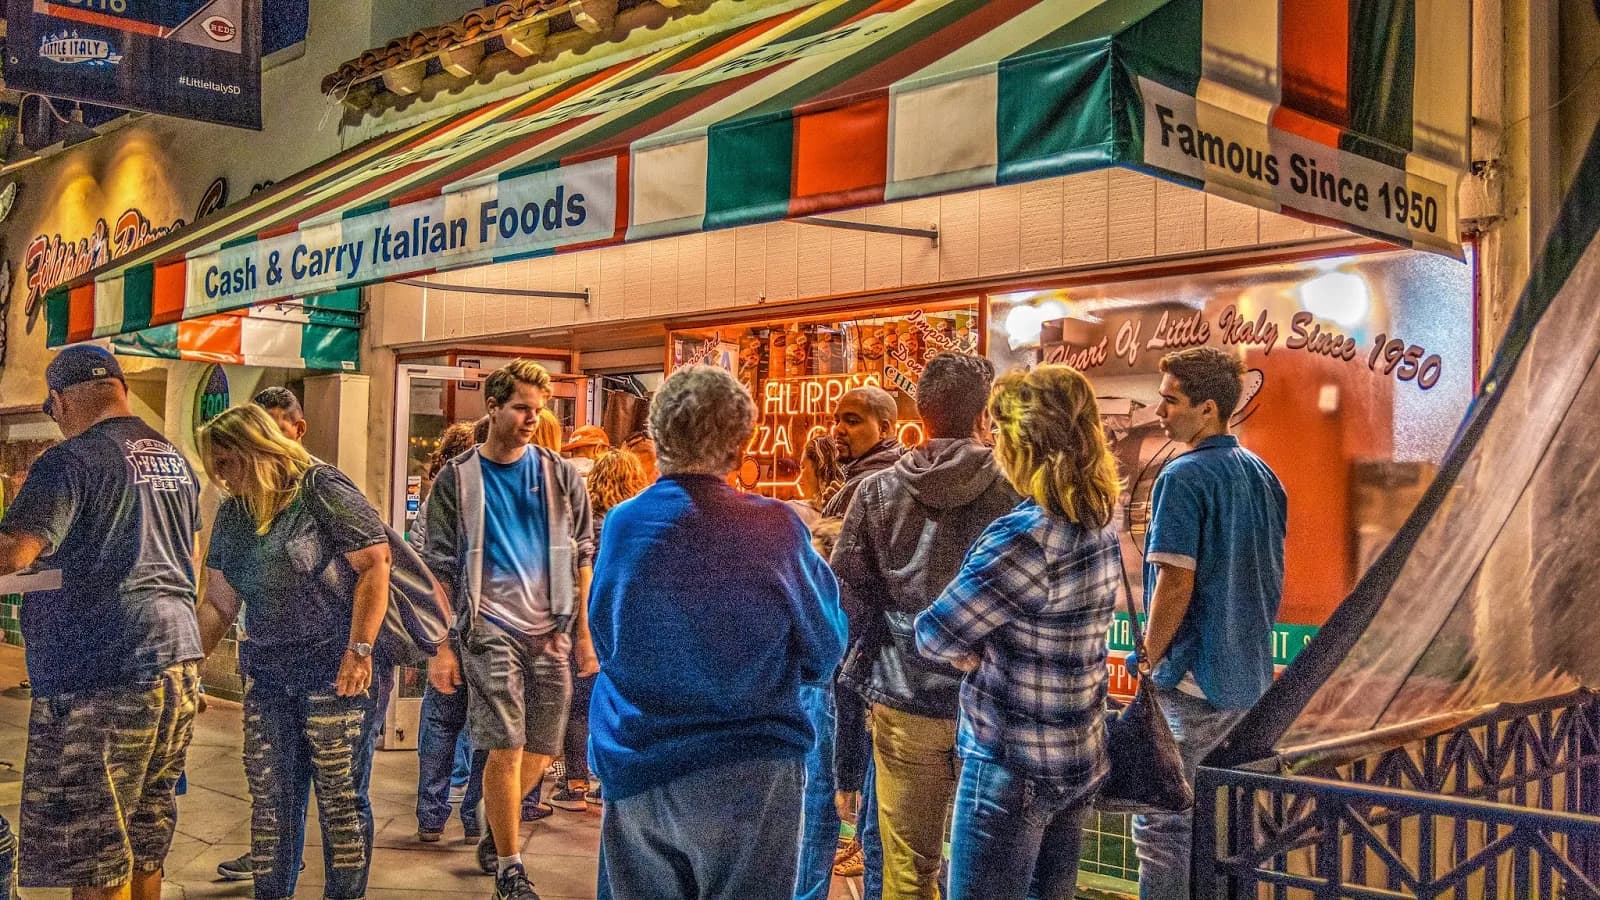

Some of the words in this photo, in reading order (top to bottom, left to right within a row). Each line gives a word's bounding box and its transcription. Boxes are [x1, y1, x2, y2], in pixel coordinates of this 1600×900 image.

[210, 23, 236, 36] REDS
[43, 41, 67, 56] LITTLE
[69, 41, 101, 56] ITALY
[179, 75, 241, 95] #LittleItalySD
[1154, 103, 1280, 186] Famous
[1289, 152, 1369, 212] Since
[1378, 181, 1438, 233] 1950
[204, 256, 257, 299] Cash
[265, 249, 283, 286] &
[290, 239, 364, 280] Carry
[372, 215, 467, 265] Italian
[479, 184, 588, 243] Foods
[1045, 335, 1108, 372] Heart
[1116, 318, 1142, 367] Of
[1146, 309, 1211, 351] Little
[1218, 304, 1280, 356] Italy
[1286, 310, 1357, 361] Since
[1367, 332, 1443, 391] 1950
[139, 455, 181, 474] VANS
